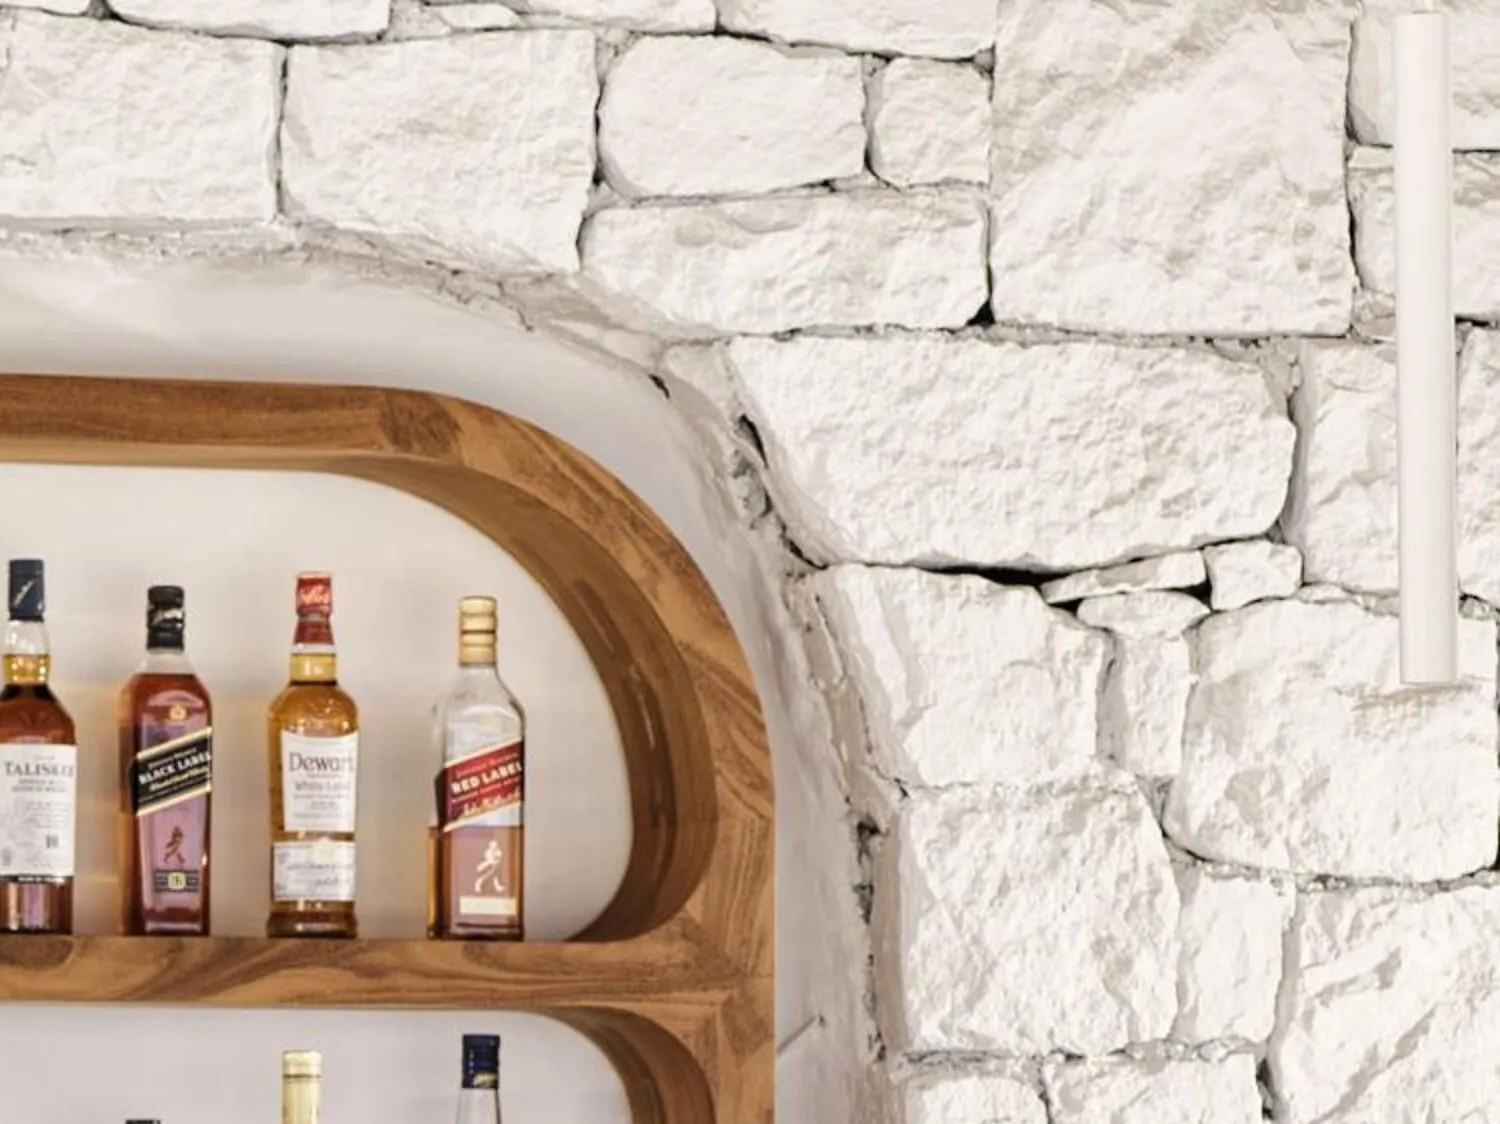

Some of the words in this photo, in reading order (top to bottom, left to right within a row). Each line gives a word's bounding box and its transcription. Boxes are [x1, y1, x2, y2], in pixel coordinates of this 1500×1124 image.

[138, 764, 175, 785] BLACK
[177, 751, 212, 771] LABEL
[451, 775, 481, 795] RED
[481, 761, 522, 784] LABEL
